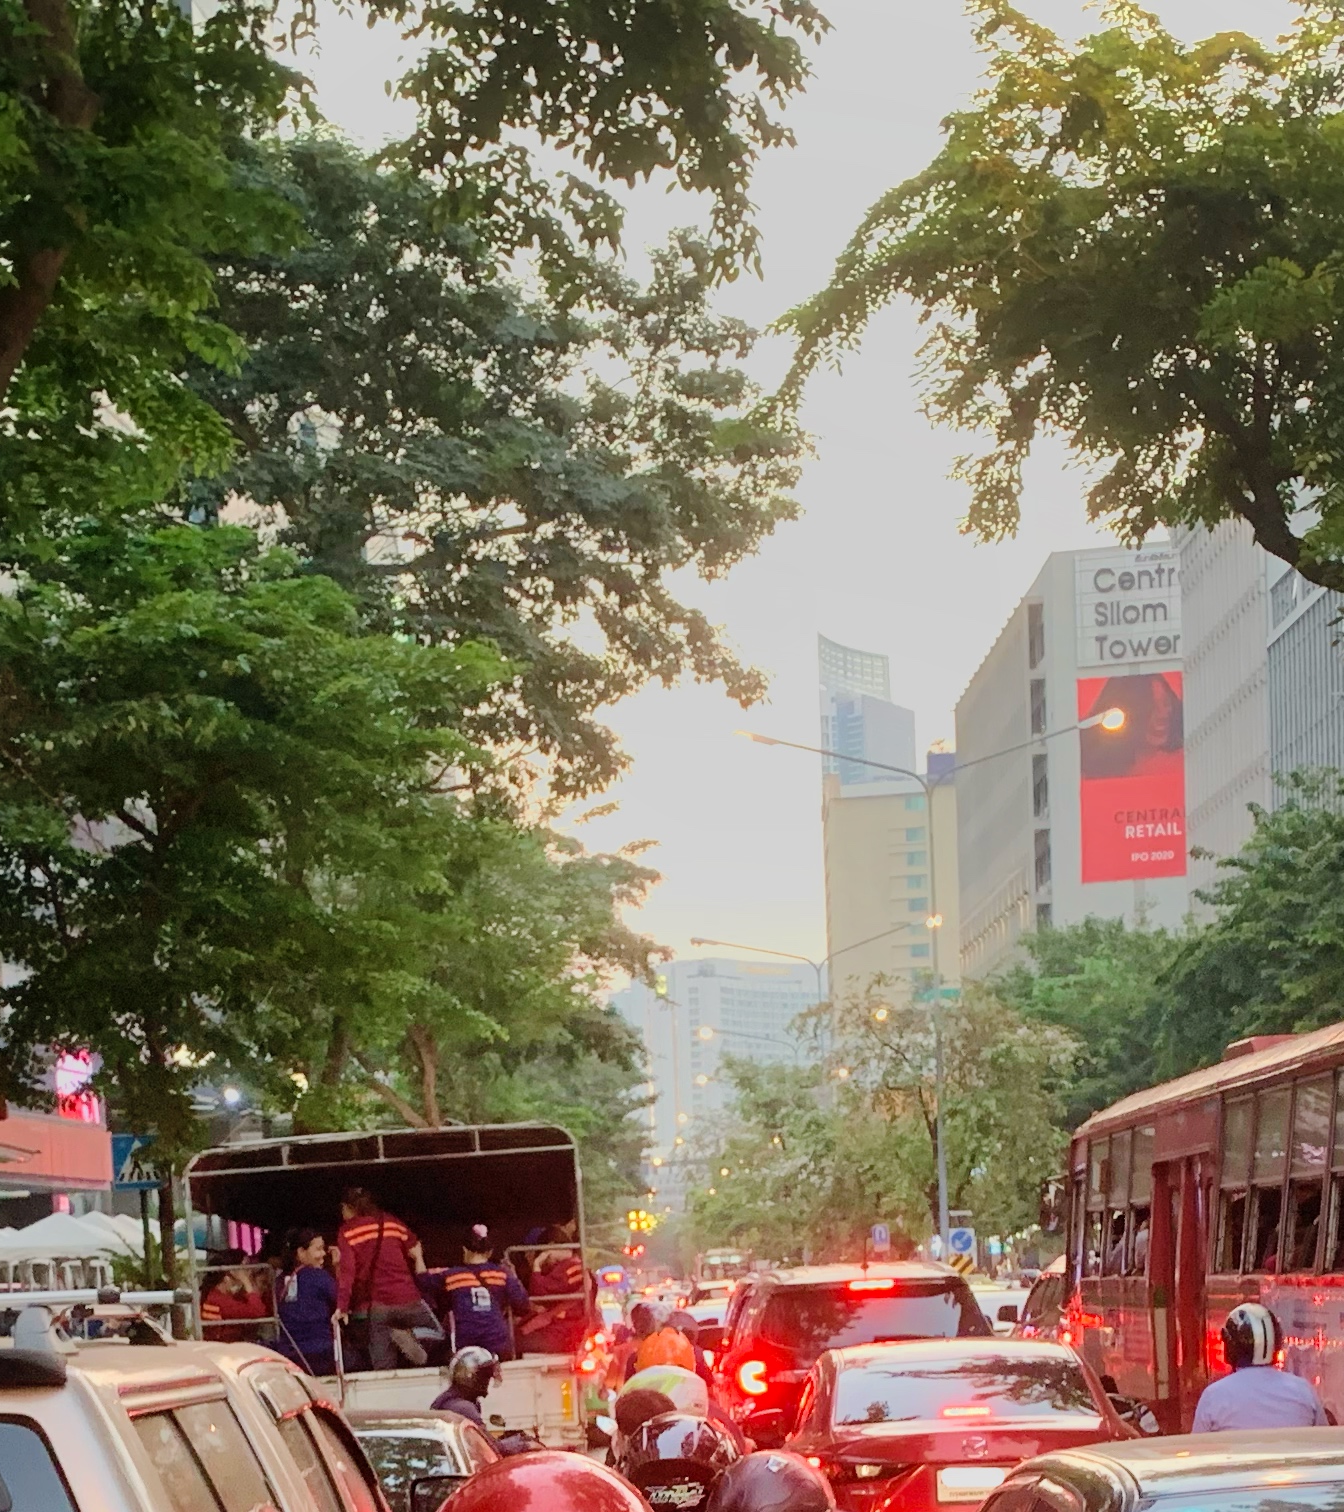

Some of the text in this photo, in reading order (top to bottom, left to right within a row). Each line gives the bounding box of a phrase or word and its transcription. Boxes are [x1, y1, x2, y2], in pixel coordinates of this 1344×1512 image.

[1094, 563, 1185, 593] Centr
[1095, 634, 1181, 660] Tower
[1125, 822, 1182, 839] RETAIL
[1131, 850, 1175, 861] IPO 2020
